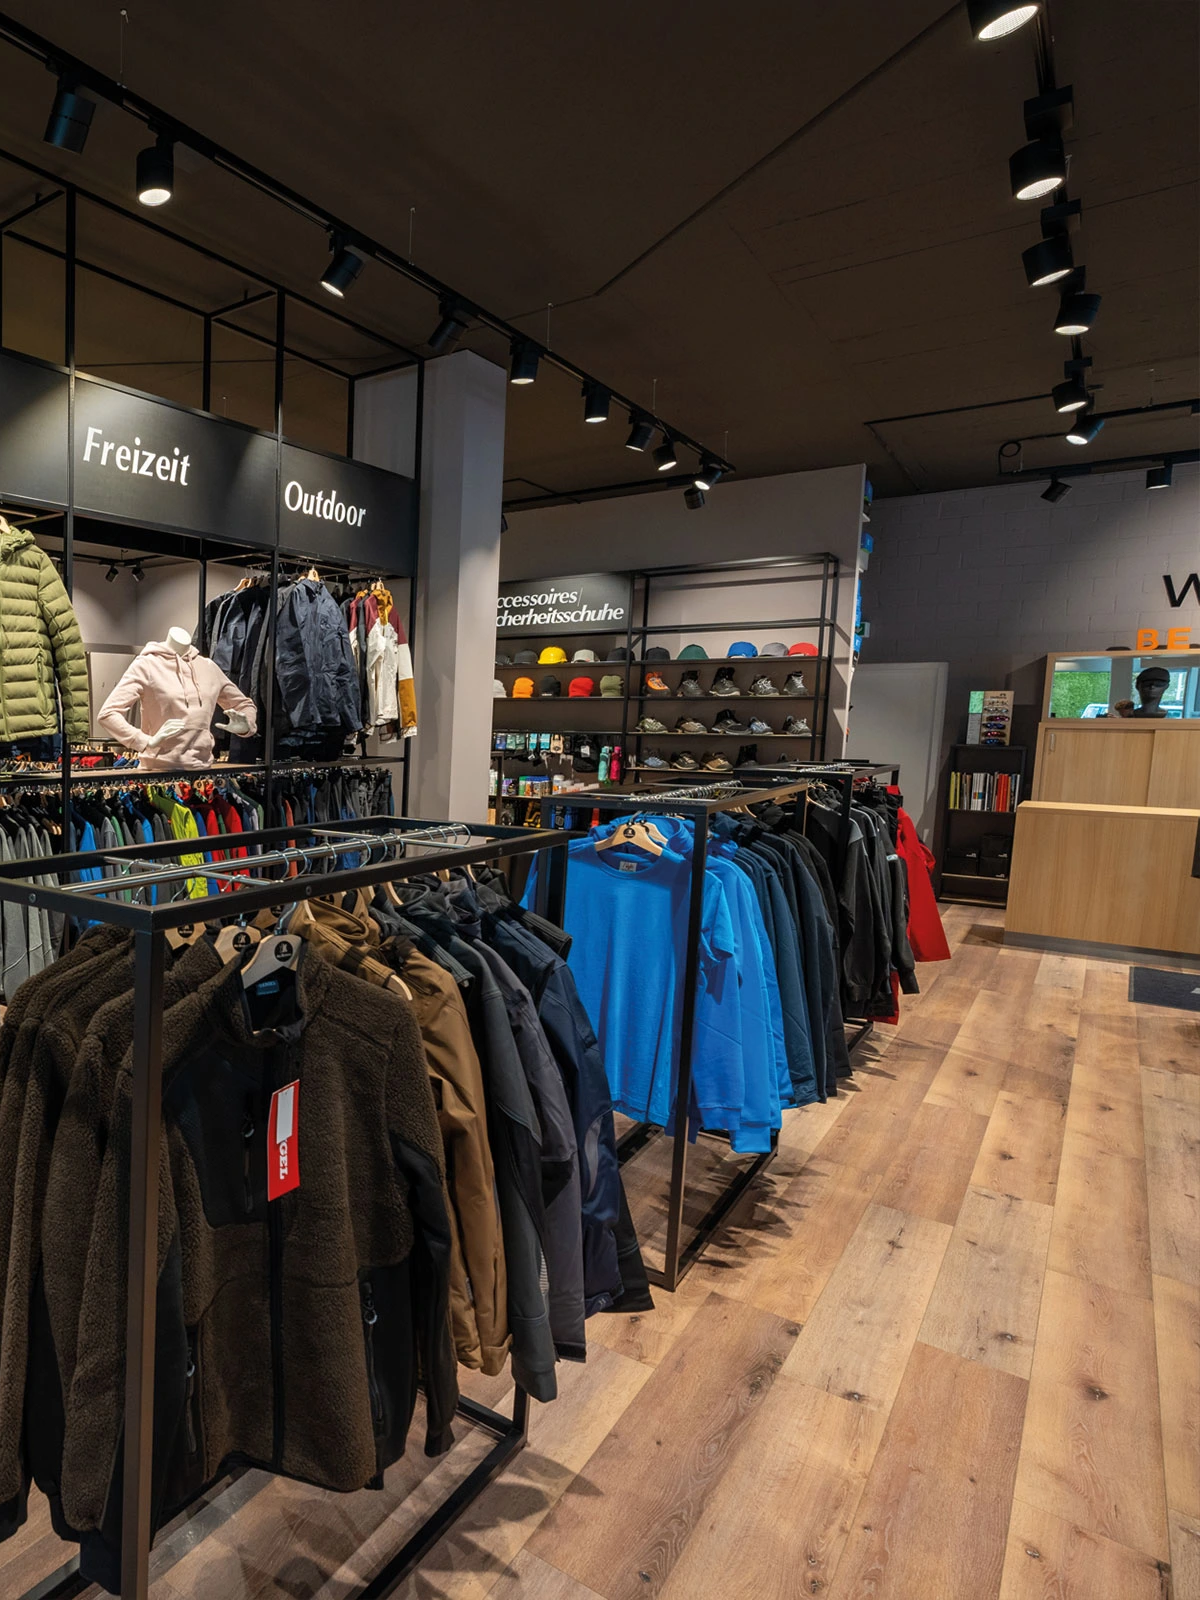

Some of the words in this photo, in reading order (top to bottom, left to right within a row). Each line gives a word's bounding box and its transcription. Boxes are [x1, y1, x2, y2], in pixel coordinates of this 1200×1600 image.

[83, 426, 191, 486] Freizeit
[284, 481, 366, 528] Outdoor
[496, 588, 578, 608] ccessoires
[496, 603, 624, 627] cherheitsschuhe
[279, 1139, 288, 1180] GEL
